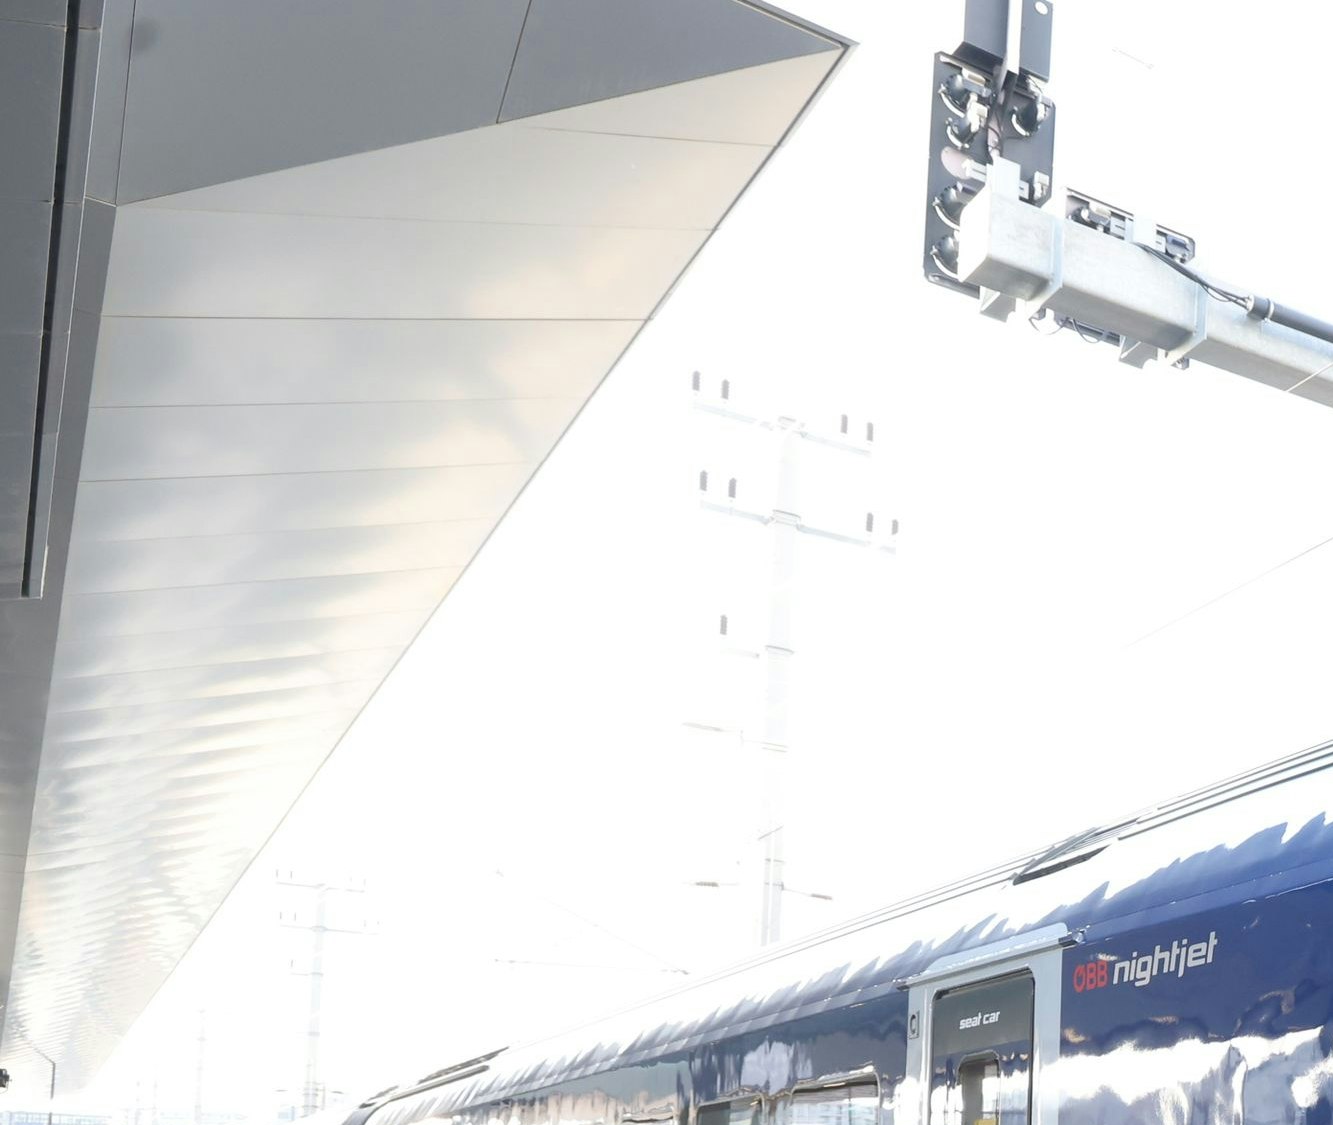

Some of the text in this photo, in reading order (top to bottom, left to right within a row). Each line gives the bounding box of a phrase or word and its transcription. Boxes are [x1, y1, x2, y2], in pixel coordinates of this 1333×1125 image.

[1113, 931, 1218, 987] nightjet
[959, 1011, 1001, 1029] seat car
